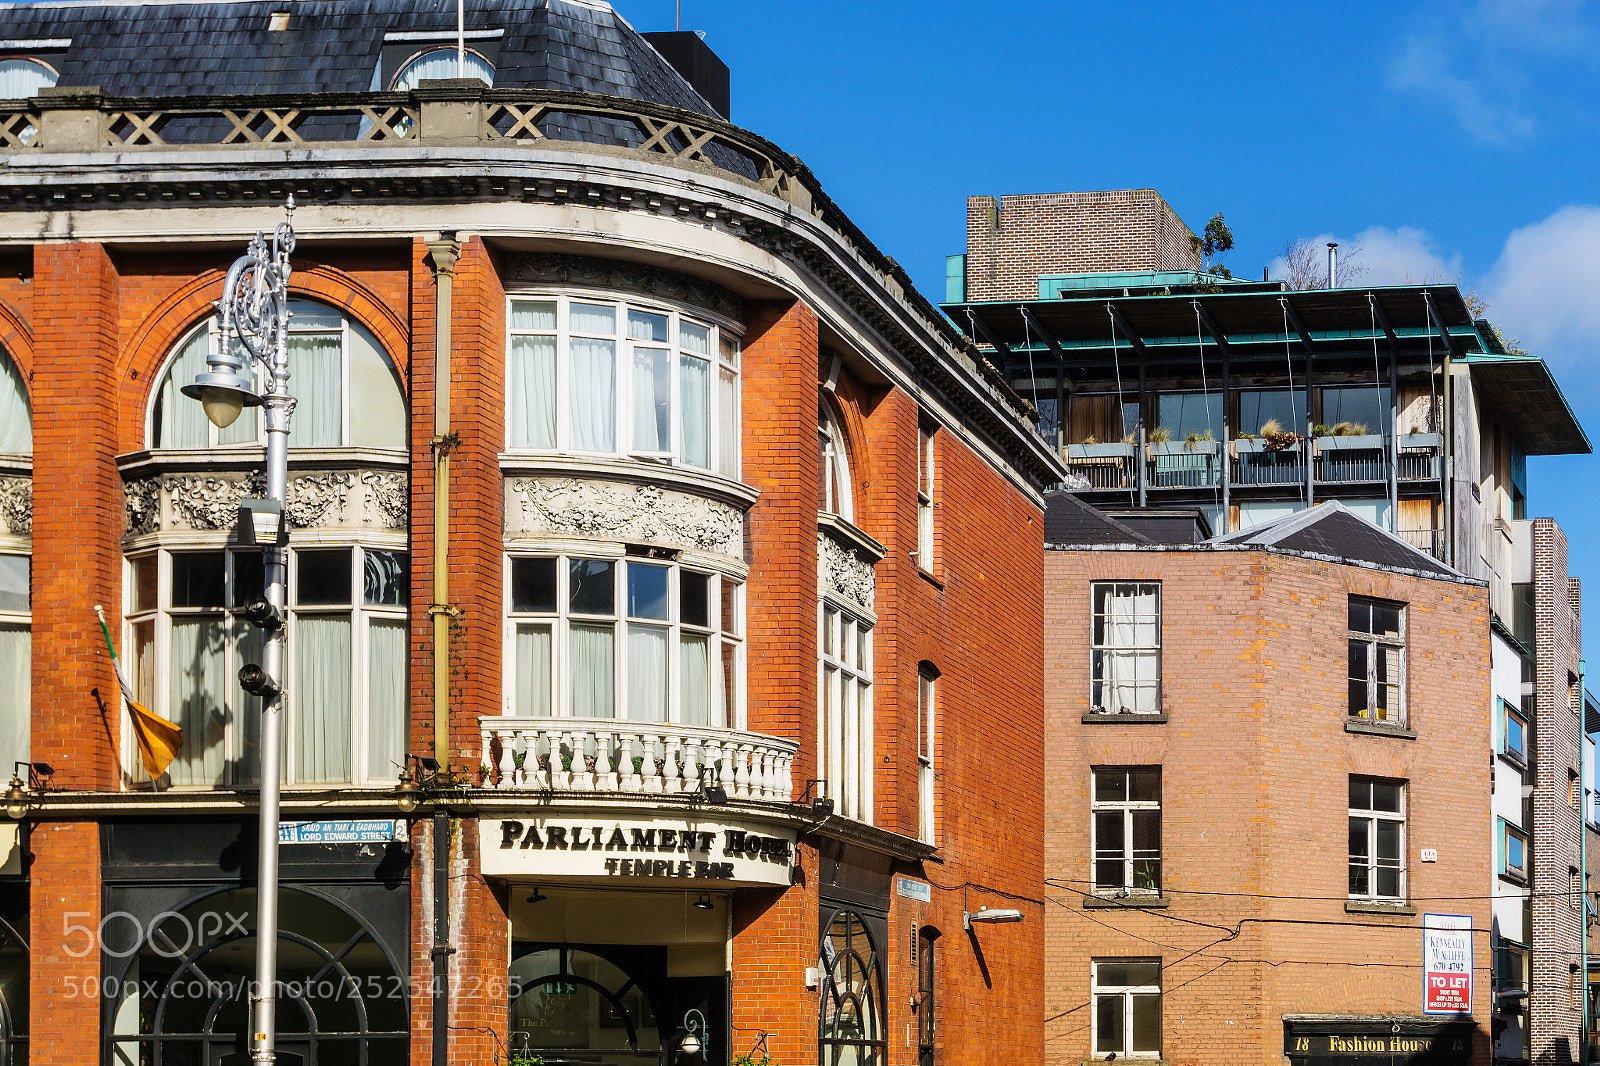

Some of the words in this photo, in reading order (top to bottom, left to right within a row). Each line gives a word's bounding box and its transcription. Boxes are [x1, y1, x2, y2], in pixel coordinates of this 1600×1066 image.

[323, 824, 332, 832] AN
[396, 825, 404, 836] 2
[300, 833, 322, 841] LORD
[324, 832, 358, 841] EDWARD
[360, 832, 391, 840] STREET
[500, 820, 717, 851] PARLIAMENT
[604, 857, 693, 878] TEMPLE
[694, 860, 736, 879] BAR
[1433, 962, 1446, 971] 670
[1448, 962, 1464, 972] 4792
[1430, 976, 1447, 988] TO
[1449, 977, 1467, 988] LET
[1295, 1037, 1310, 1051] 18
[1329, 1035, 1385, 1052] Fashion
[1388, 1035, 1432, 1052] House
